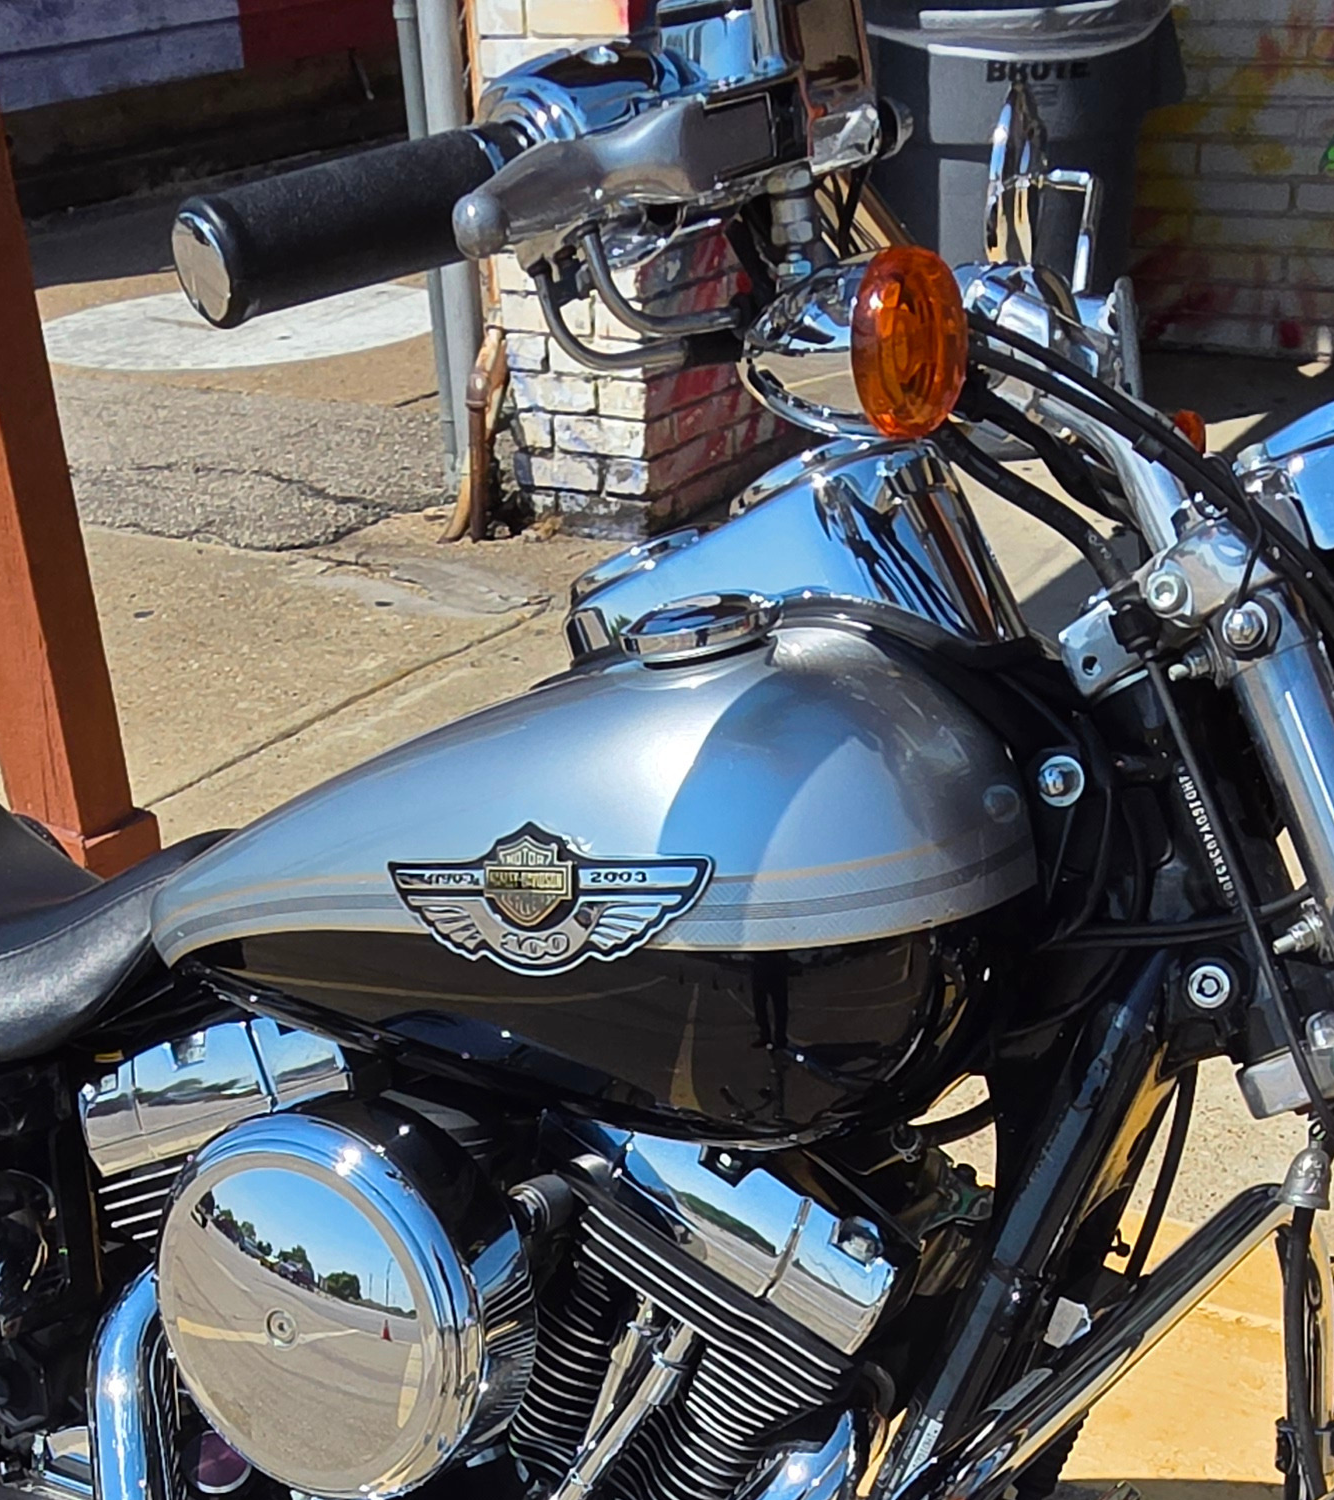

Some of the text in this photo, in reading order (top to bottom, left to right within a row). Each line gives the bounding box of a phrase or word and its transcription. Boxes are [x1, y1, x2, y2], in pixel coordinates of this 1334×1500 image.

[987, 60, 1090, 82] BRUTE
[506, 848, 545, 865] MOTOR
[590, 871, 648, 884] 2003
[500, 932, 570, 960] 100
